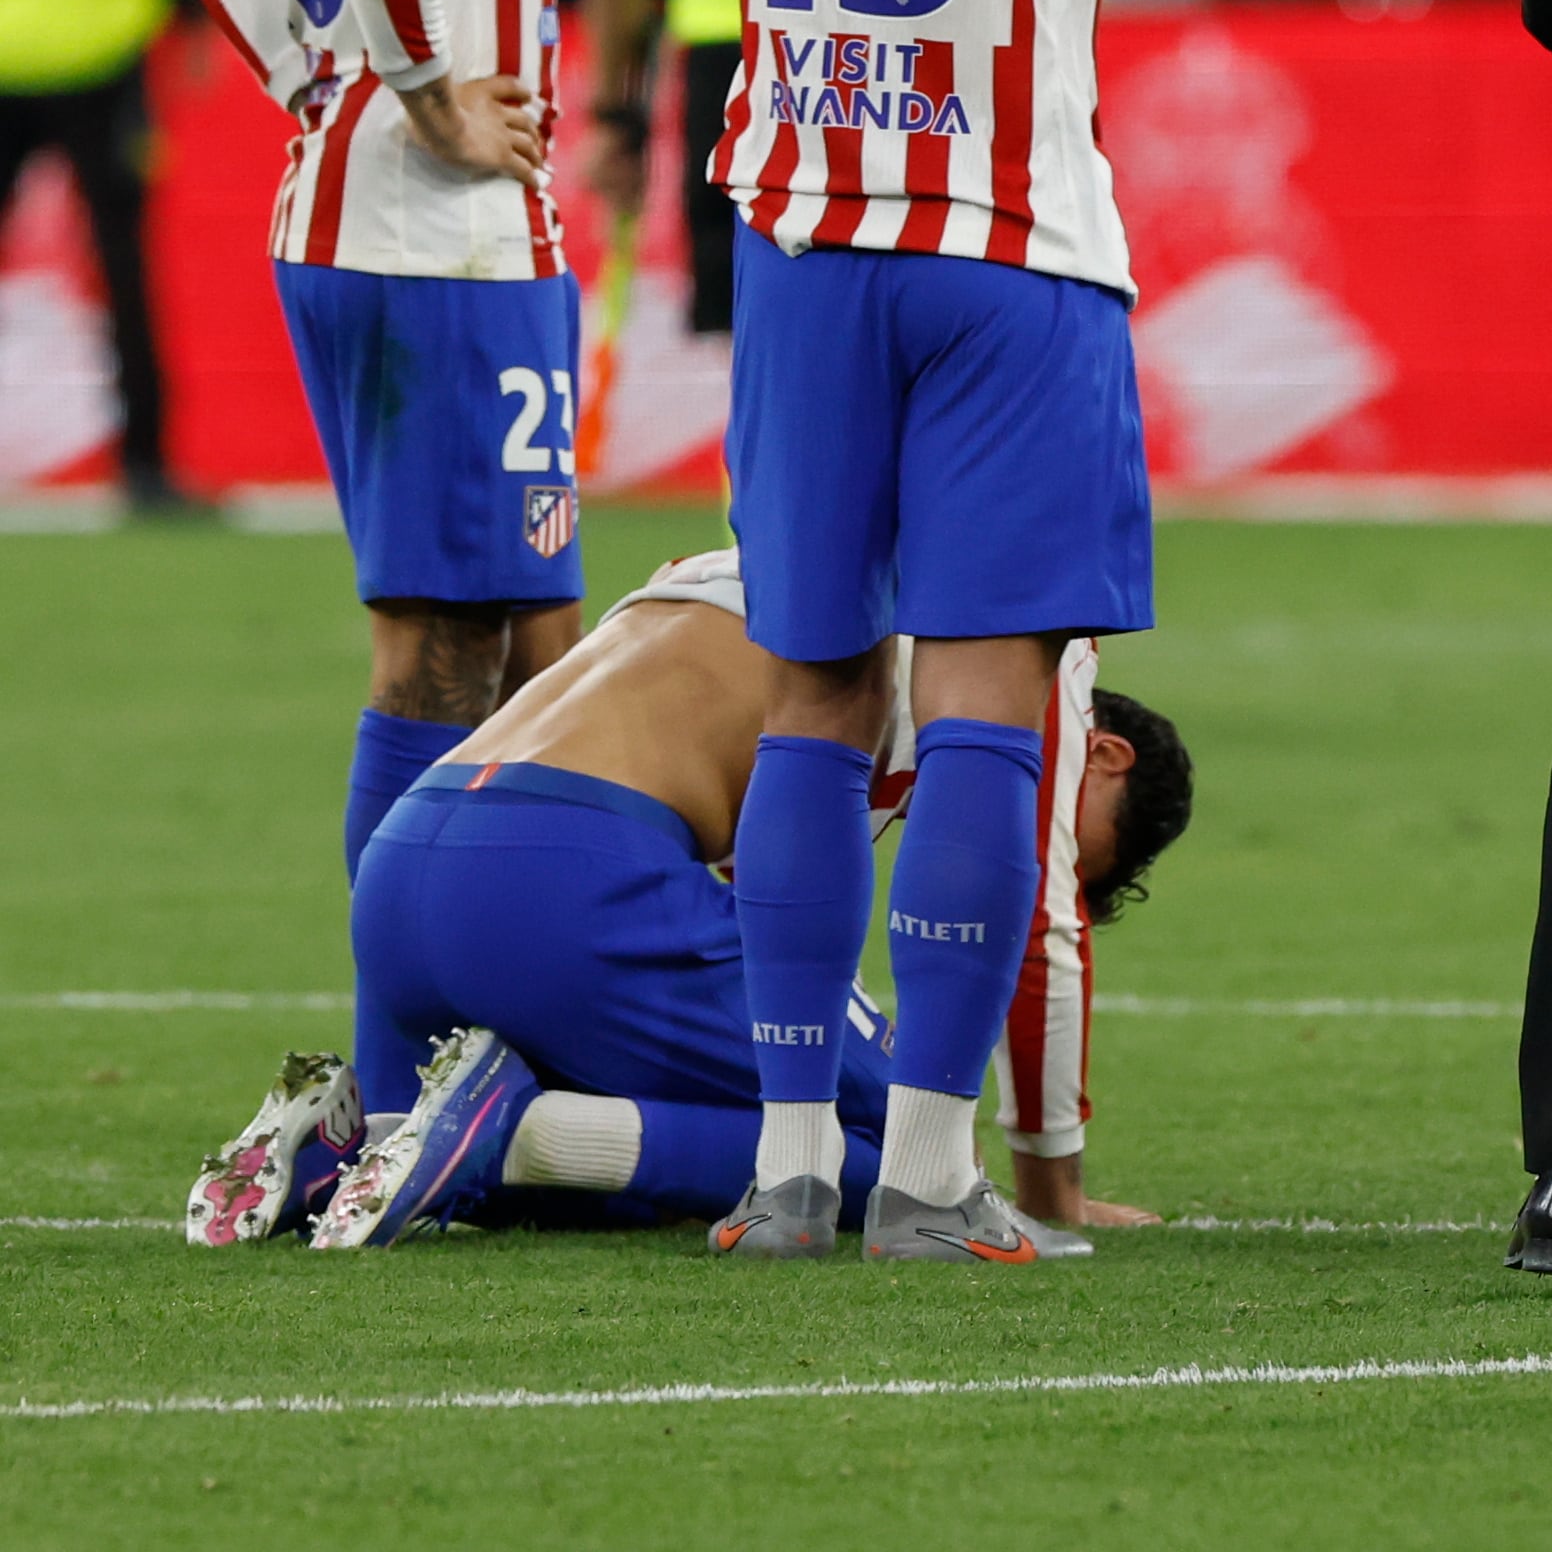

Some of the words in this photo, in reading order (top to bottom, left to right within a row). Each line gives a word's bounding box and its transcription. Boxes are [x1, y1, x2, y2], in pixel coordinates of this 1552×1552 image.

[781, 34, 923, 85] VISIT
[889, 909, 986, 944] ATLETI
[752, 1021, 825, 1046] ATLETI
